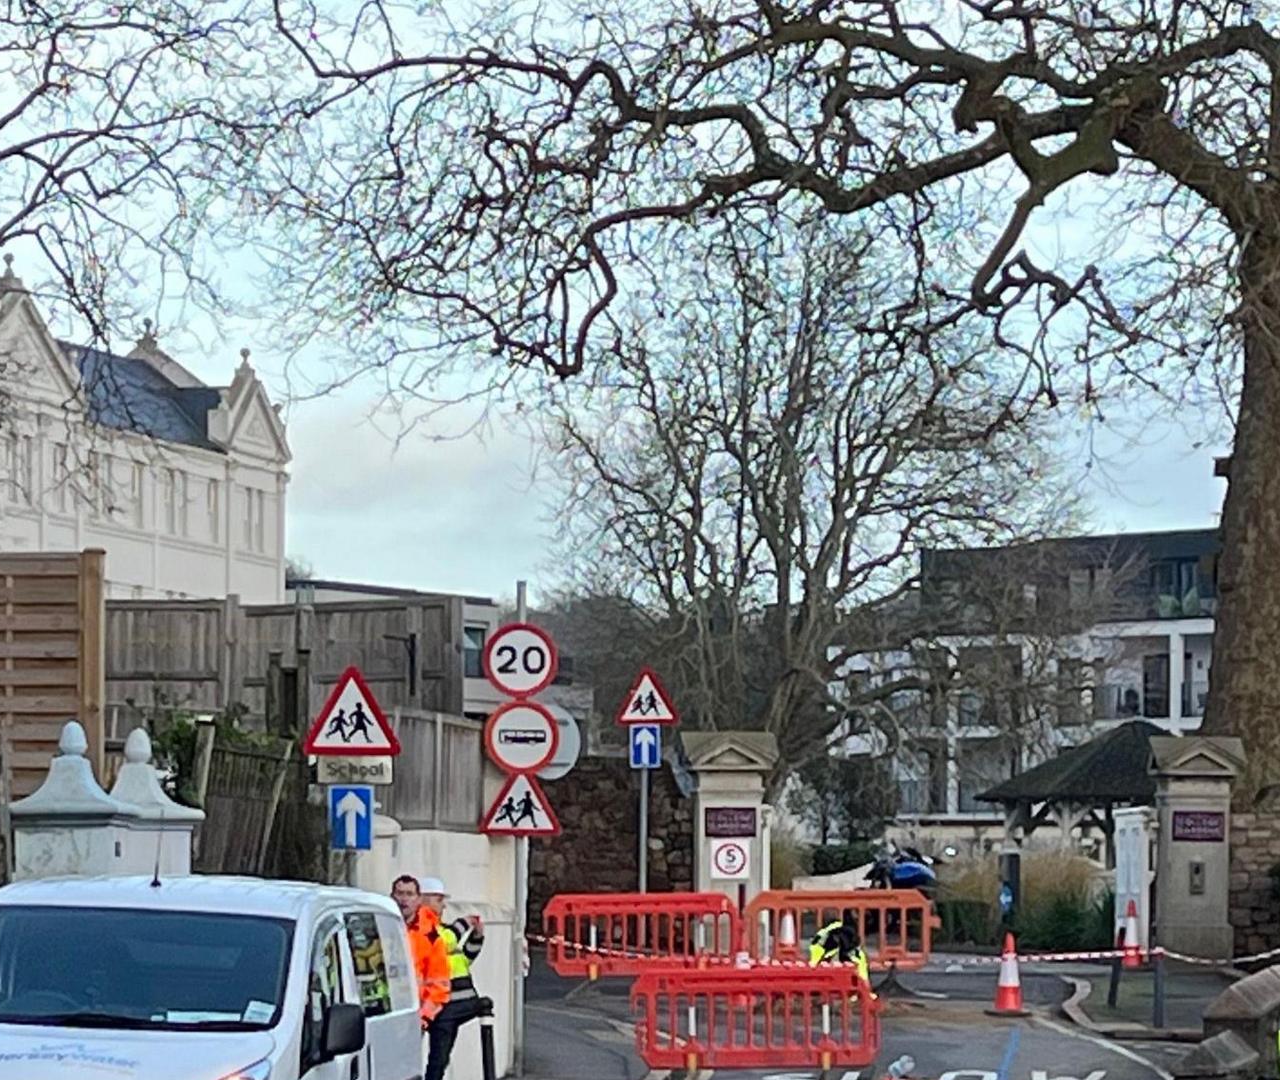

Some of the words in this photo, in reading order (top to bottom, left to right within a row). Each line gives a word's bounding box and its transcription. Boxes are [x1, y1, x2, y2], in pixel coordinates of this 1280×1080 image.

[497, 646, 545, 674] 20
[326, 762, 384, 777] School
[725, 849, 736, 863] 5
